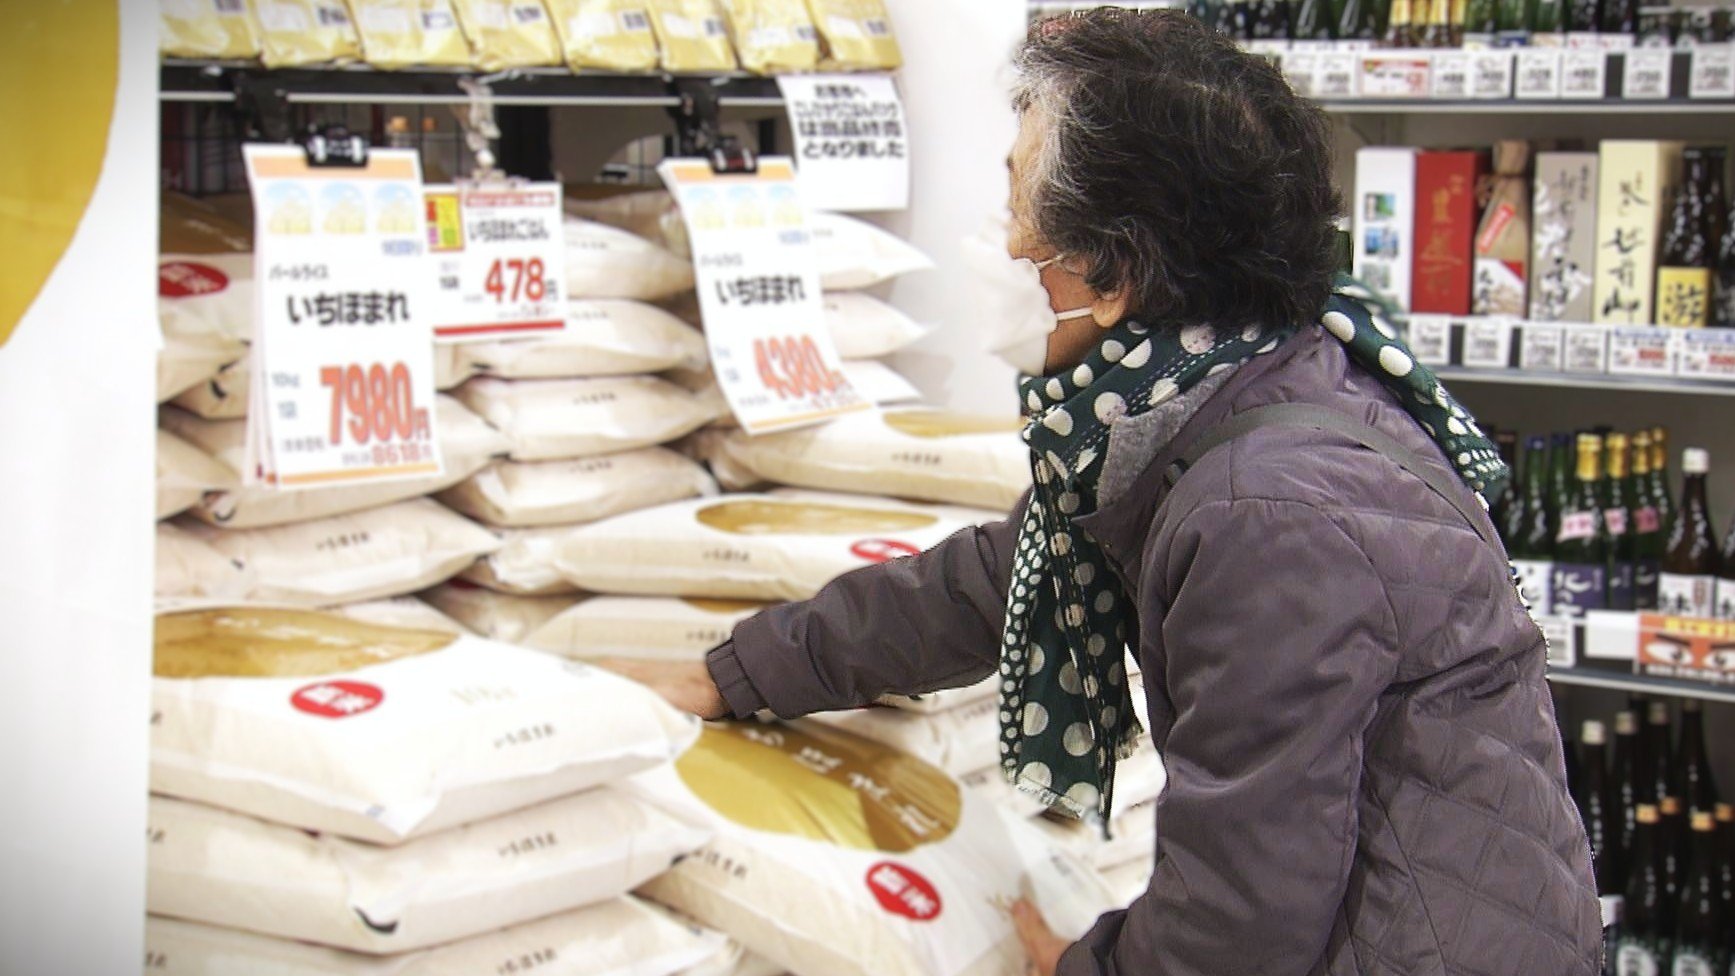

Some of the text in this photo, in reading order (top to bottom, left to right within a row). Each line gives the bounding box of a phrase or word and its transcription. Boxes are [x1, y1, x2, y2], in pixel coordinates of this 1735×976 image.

[803, 140, 905, 158] となりました
[716, 274, 807, 304] いちほまれ
[287, 291, 411, 326] いちほまれ
